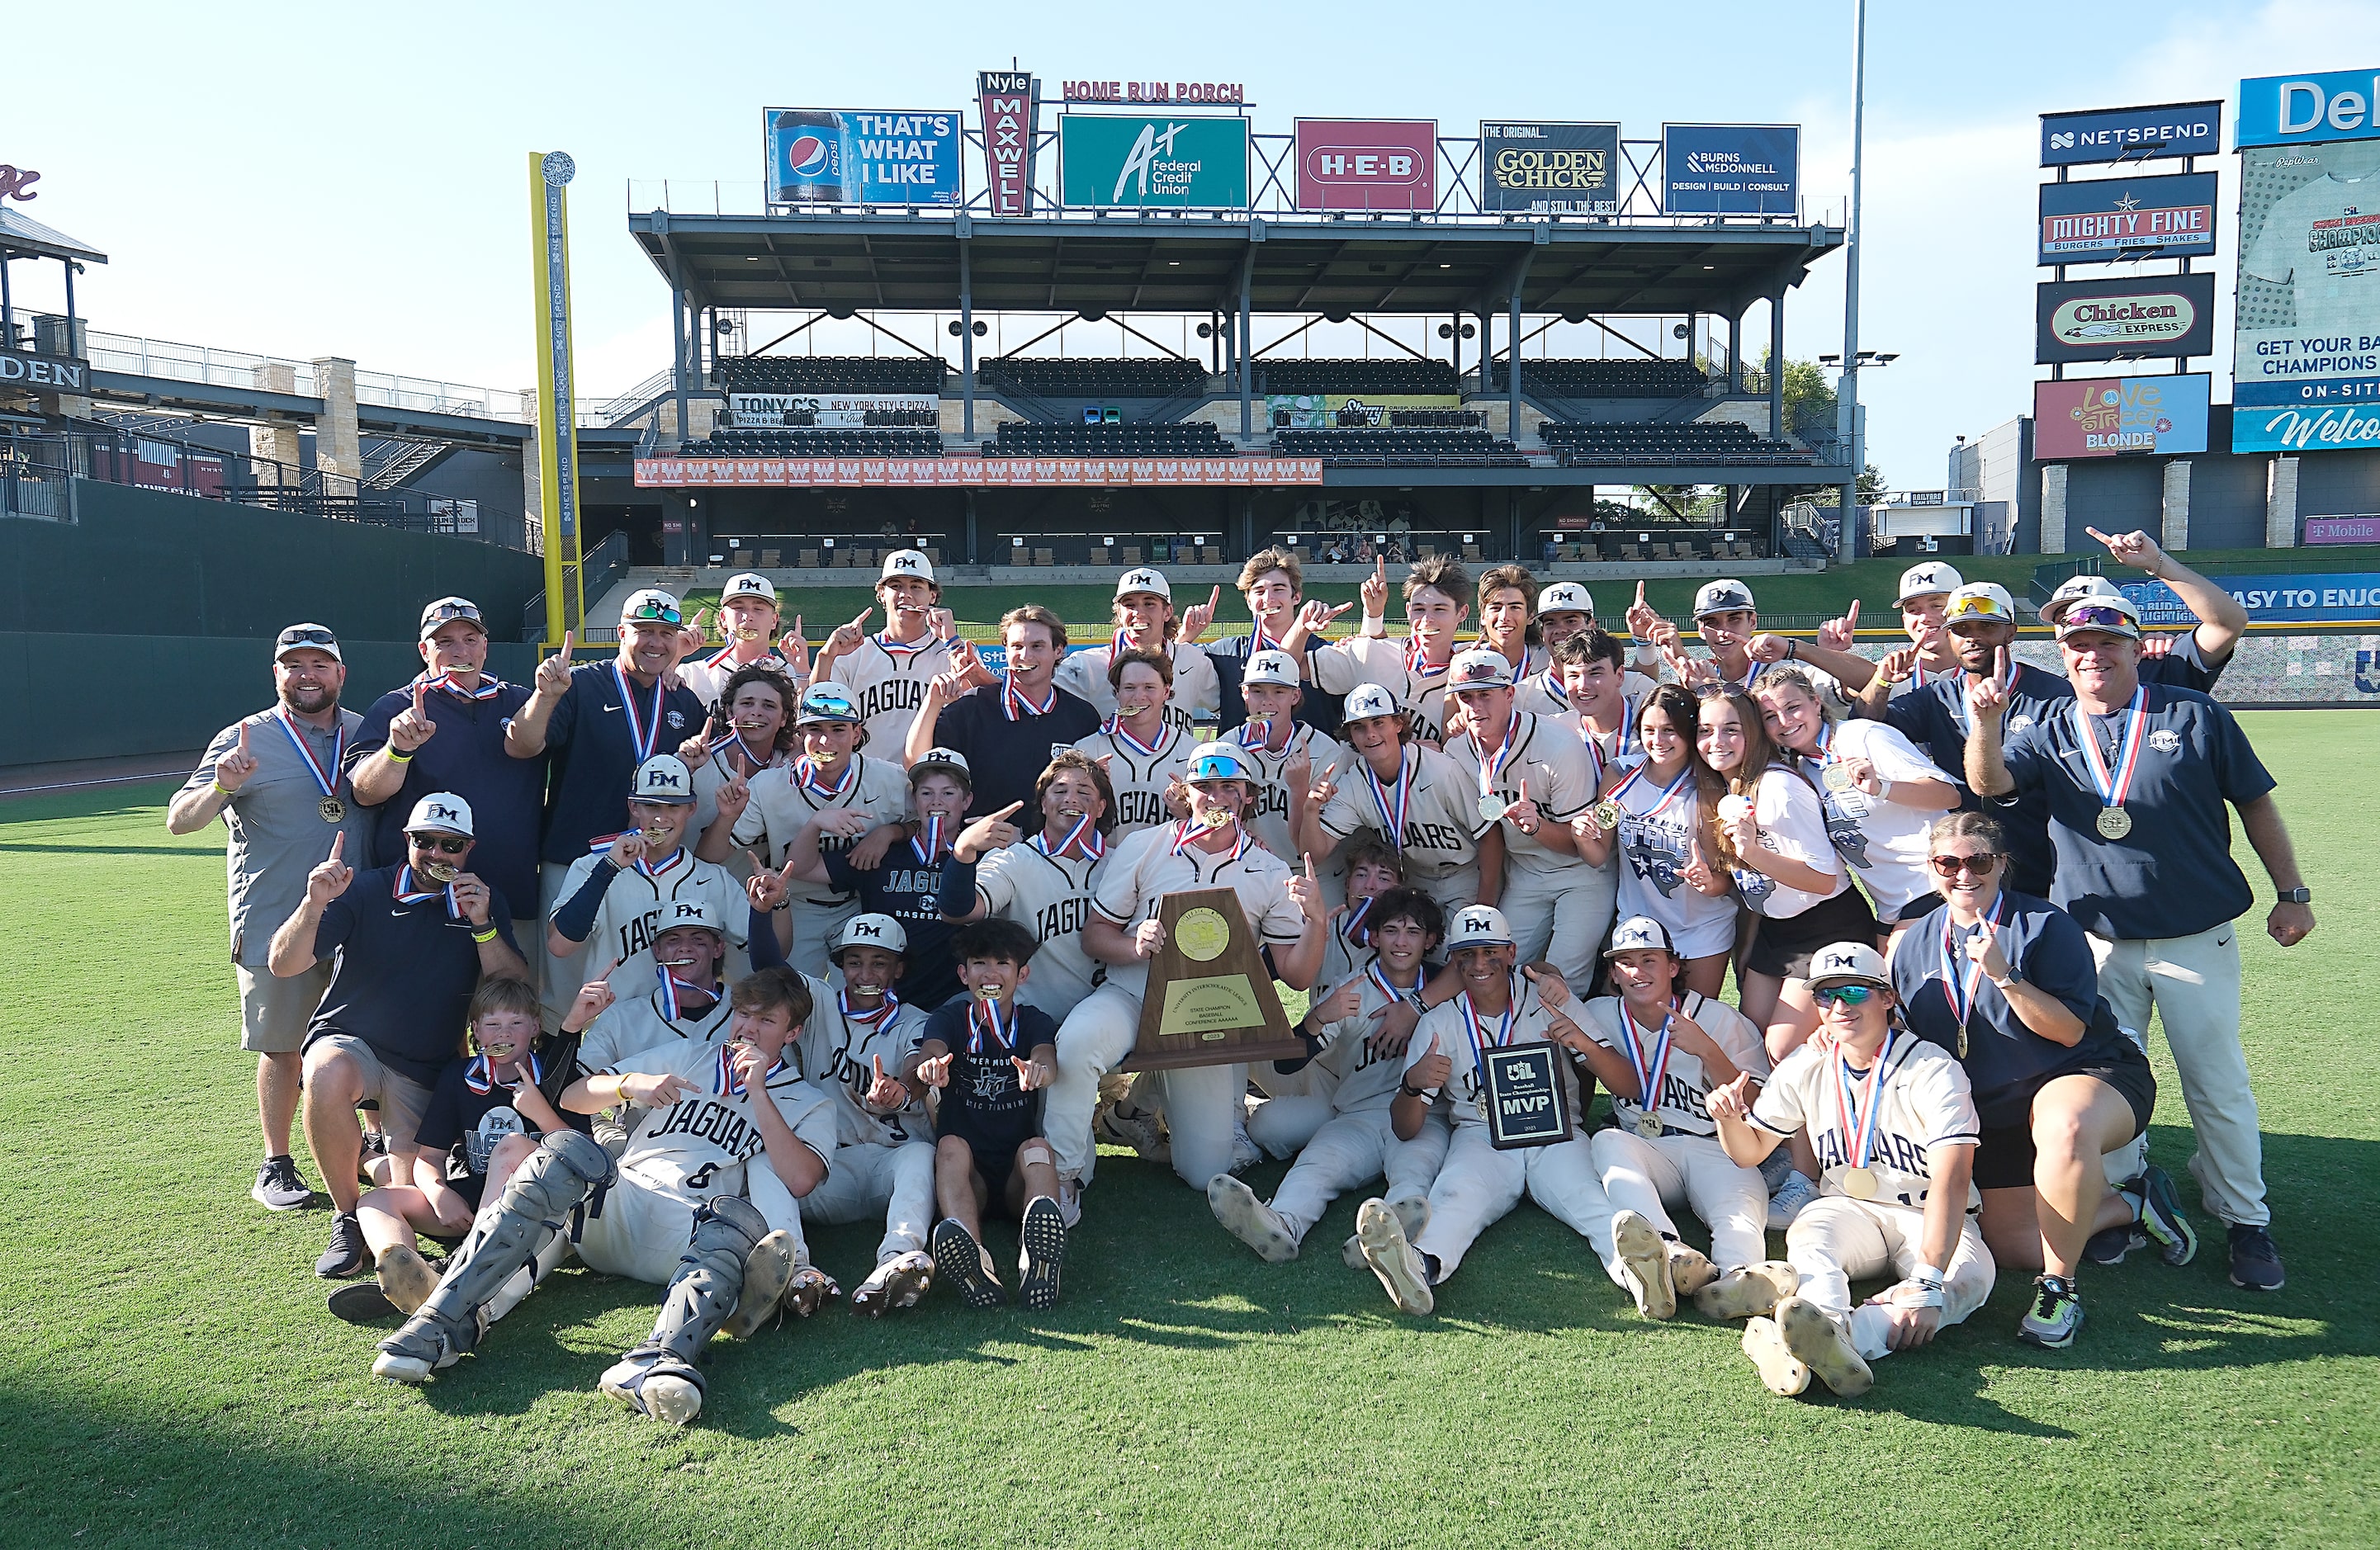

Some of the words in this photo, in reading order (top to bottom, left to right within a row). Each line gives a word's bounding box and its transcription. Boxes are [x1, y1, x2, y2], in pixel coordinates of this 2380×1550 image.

[987, 73, 1026, 93] Nyle
[1062, 81, 1120, 102] HOME
[1128, 82, 1169, 102] RUN
[1176, 83, 1244, 104] PORCH
[857, 115, 950, 137] THAT'S
[1484, 126, 1501, 138] THE
[2080, 122, 2209, 146] NETSPEND
[828, 139, 841, 177] pepsi
[858, 139, 938, 161] WHAT
[992, 98, 1024, 210] MAXWELL
[1701, 153, 1740, 163] BURNS
[1152, 159, 1201, 172] Federal
[1497, 150, 1605, 172] GOLDEN
[863, 163, 869, 183] I
[878, 163, 937, 184] LIKE
[1152, 172, 1192, 183] Credit
[1507, 168, 1592, 188] CHICK
[1152, 182, 1190, 195] Union
[1672, 182, 1706, 191] DESIGN
[1713, 182, 1741, 191] BUILD
[1748, 183, 1790, 191] CONSULT
[1550, 201, 1573, 212] STILL
[1575, 201, 1592, 212] THE
[1594, 201, 1616, 212] BEST
[2051, 213, 2140, 242] MIGHTY
[2151, 208, 2203, 234] FINE
[2054, 239, 2103, 250] BURGERS
[2114, 237, 2146, 247] FRIES
[2155, 234, 2200, 244] SHAKES
[2074, 302, 2178, 323] Chicken
[2125, 322, 2179, 333] EXPRESS
[2256, 340, 2294, 356] GET
[2300, 337, 2352, 353] YOUR
[2263, 355, 2378, 375] CHAMPIONS
[2302, 382, 2380, 399] ON-SIT
[739, 398, 788, 414] TONY
[830, 400, 852, 411] NEW
[854, 400, 876, 411] YORK
[878, 400, 905, 411] STYLE
[906, 400, 930, 411] PIZZA
[2264, 408, 2380, 449] Welco
[2086, 432, 2155, 450] BLONDE
[561, 456, 571, 510] NETSPEND
[2328, 523, 2374, 537] Mobile
[894, 556, 917, 569] FM
[738, 579, 762, 591] FM
[1129, 573, 1152, 585] FM
[1909, 571, 1936, 585] FM
[1550, 589, 1574, 602] FM
[2283, 589, 2316, 608] TO
[2147, 602, 2173, 611] BUD
[1256, 659, 1280, 673] FM
[859, 678, 930, 724] JAGUA
[1354, 695, 1384, 712] FM
[927, 752, 951, 763] FM
[646, 770, 681, 789] FM
[424, 803, 461, 825] FM
[674, 904, 704, 919] FM
[854, 923, 882, 938] FM
[1464, 918, 1491, 933] FM
[617, 909, 663, 967] JAG
[1621, 929, 1652, 944] FM
[1824, 953, 1856, 968] FM
[1172, 990, 1193, 1014] UNIVERSITY
[1191, 983, 1233, 995] INTERSCHOLASTIC
[1185, 1018, 1218, 1026] CONFERENCE
[1512, 1087, 1550, 1096] Championships
[1502, 1095, 1550, 1115] MVP
[1818, 1127, 1932, 1179] JAARS
